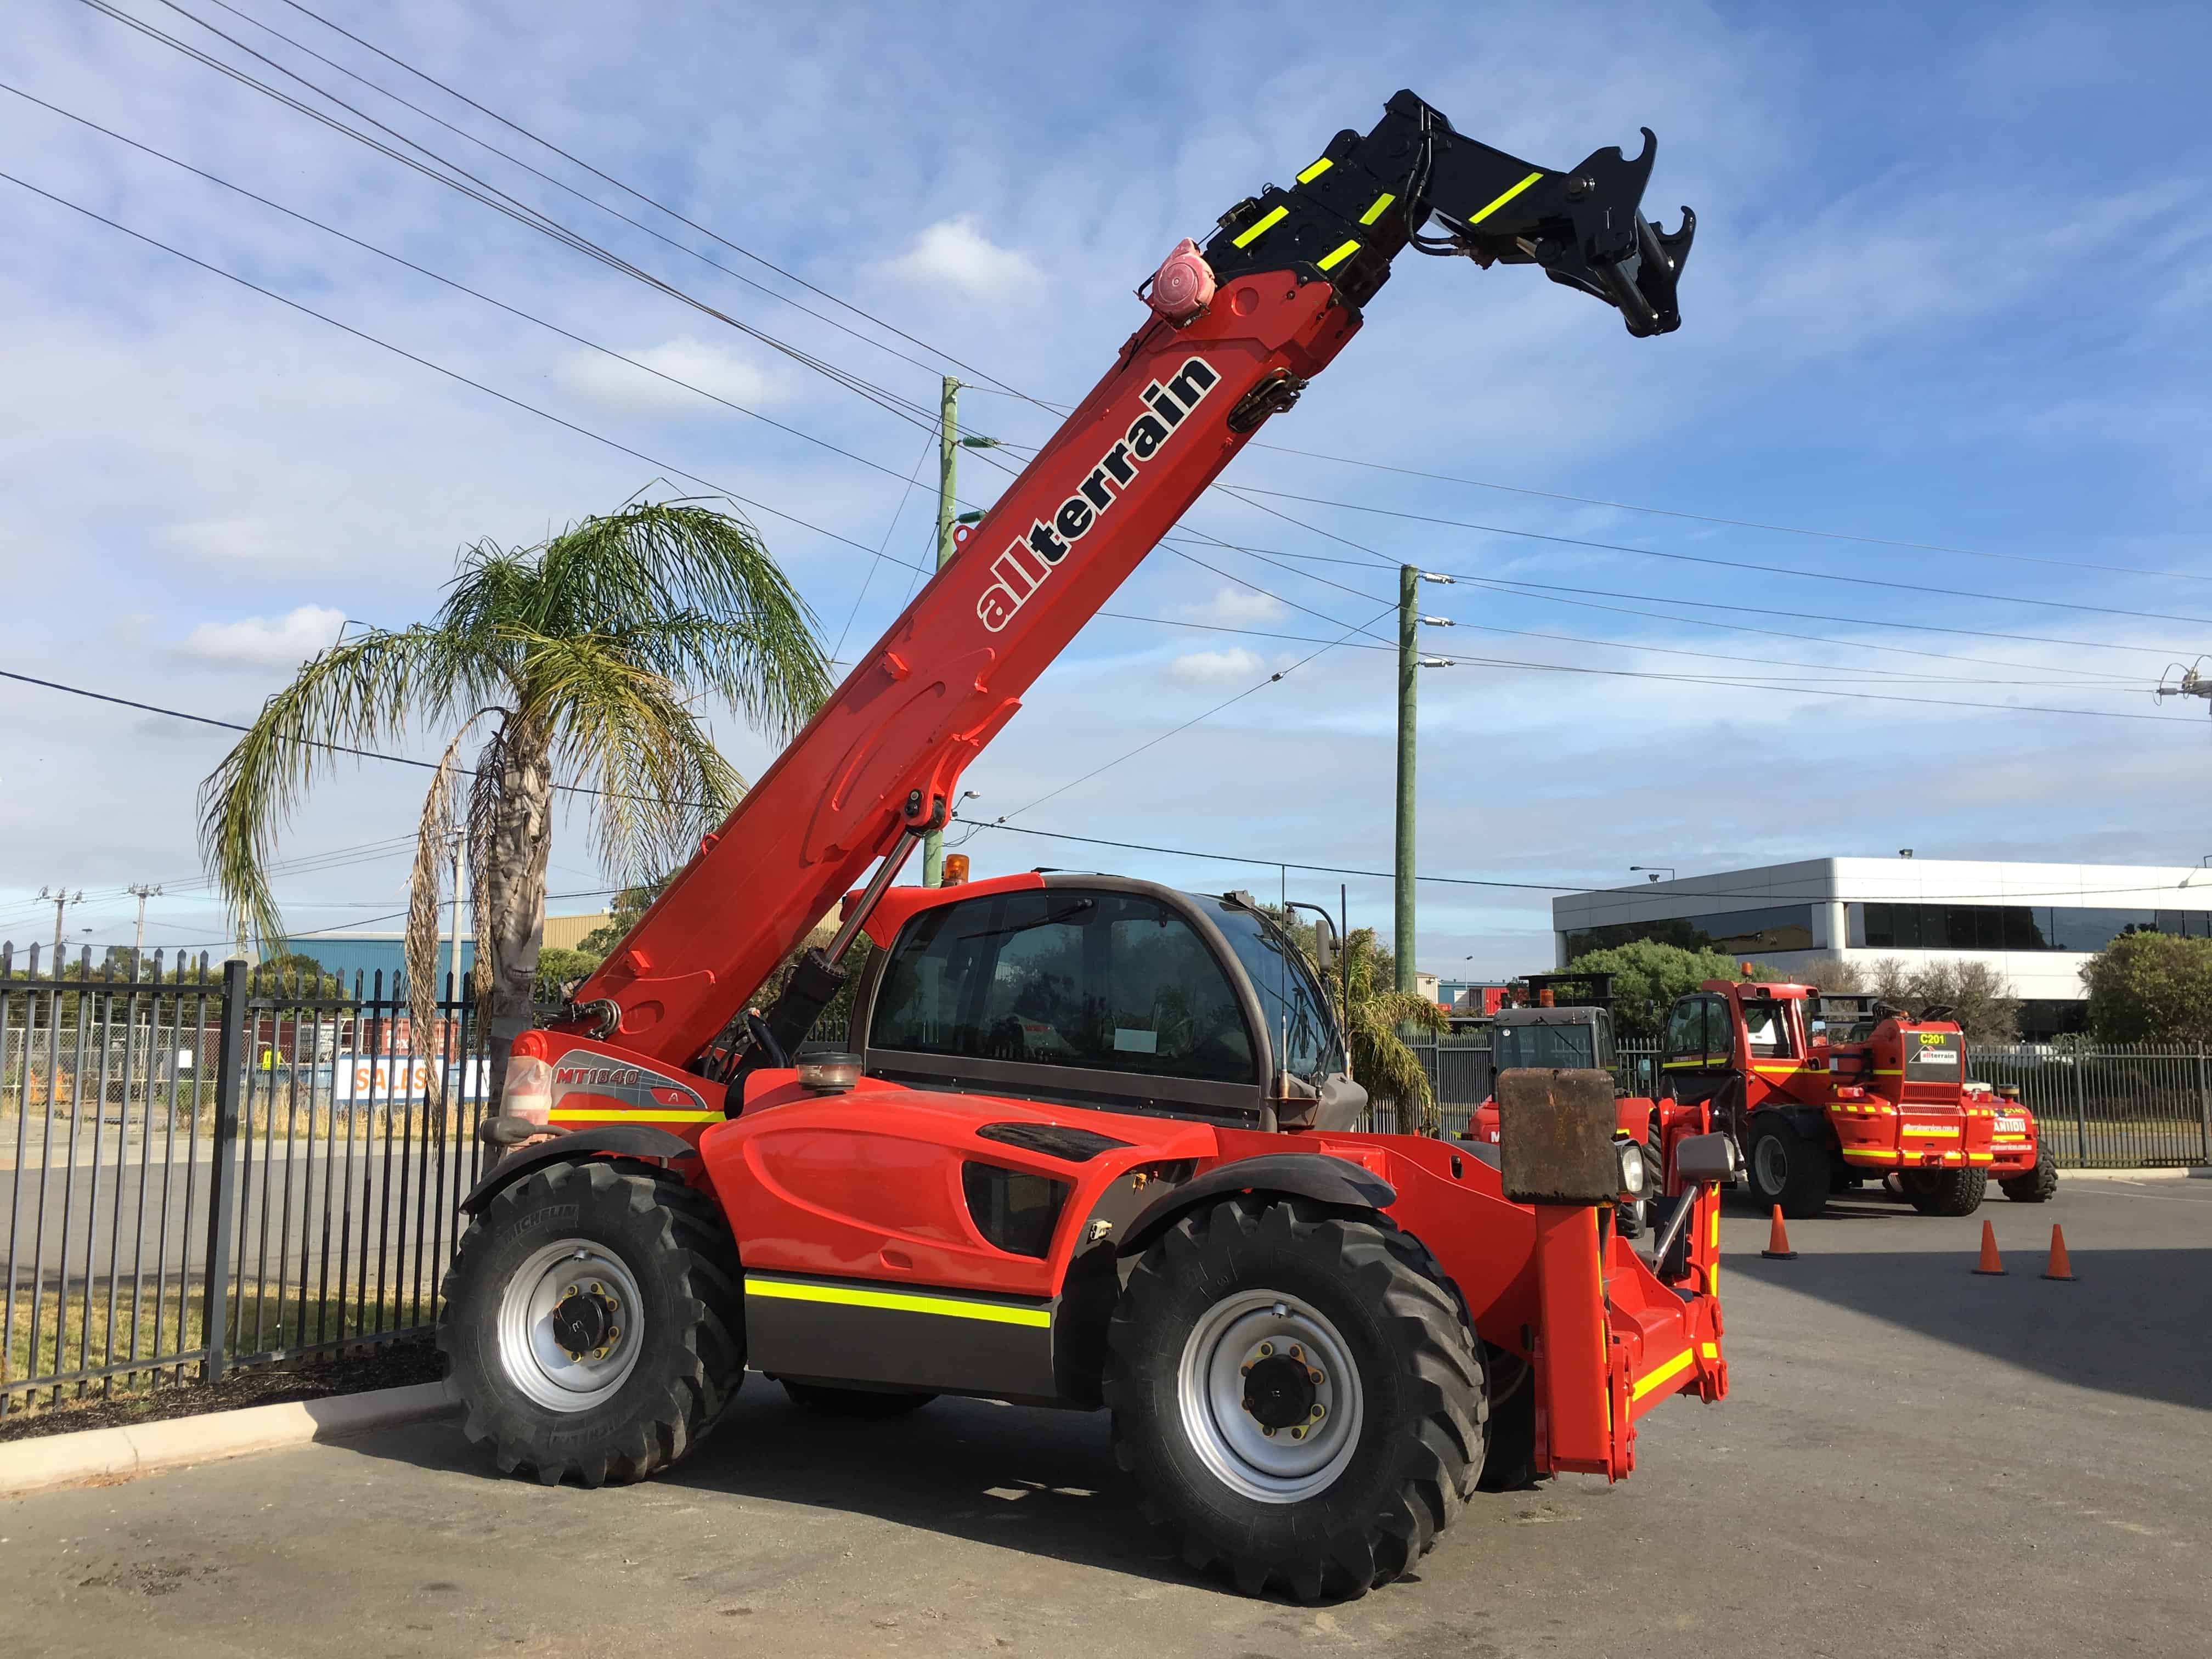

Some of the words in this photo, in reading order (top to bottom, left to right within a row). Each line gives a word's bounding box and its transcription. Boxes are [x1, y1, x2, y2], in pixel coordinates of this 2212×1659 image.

[977, 356, 1222, 633] allterrain
[1920, 1034, 1944, 1043] C201
[556, 1068, 639, 1085] MT1840
[1994, 1118, 2025, 1132] ANITOU
